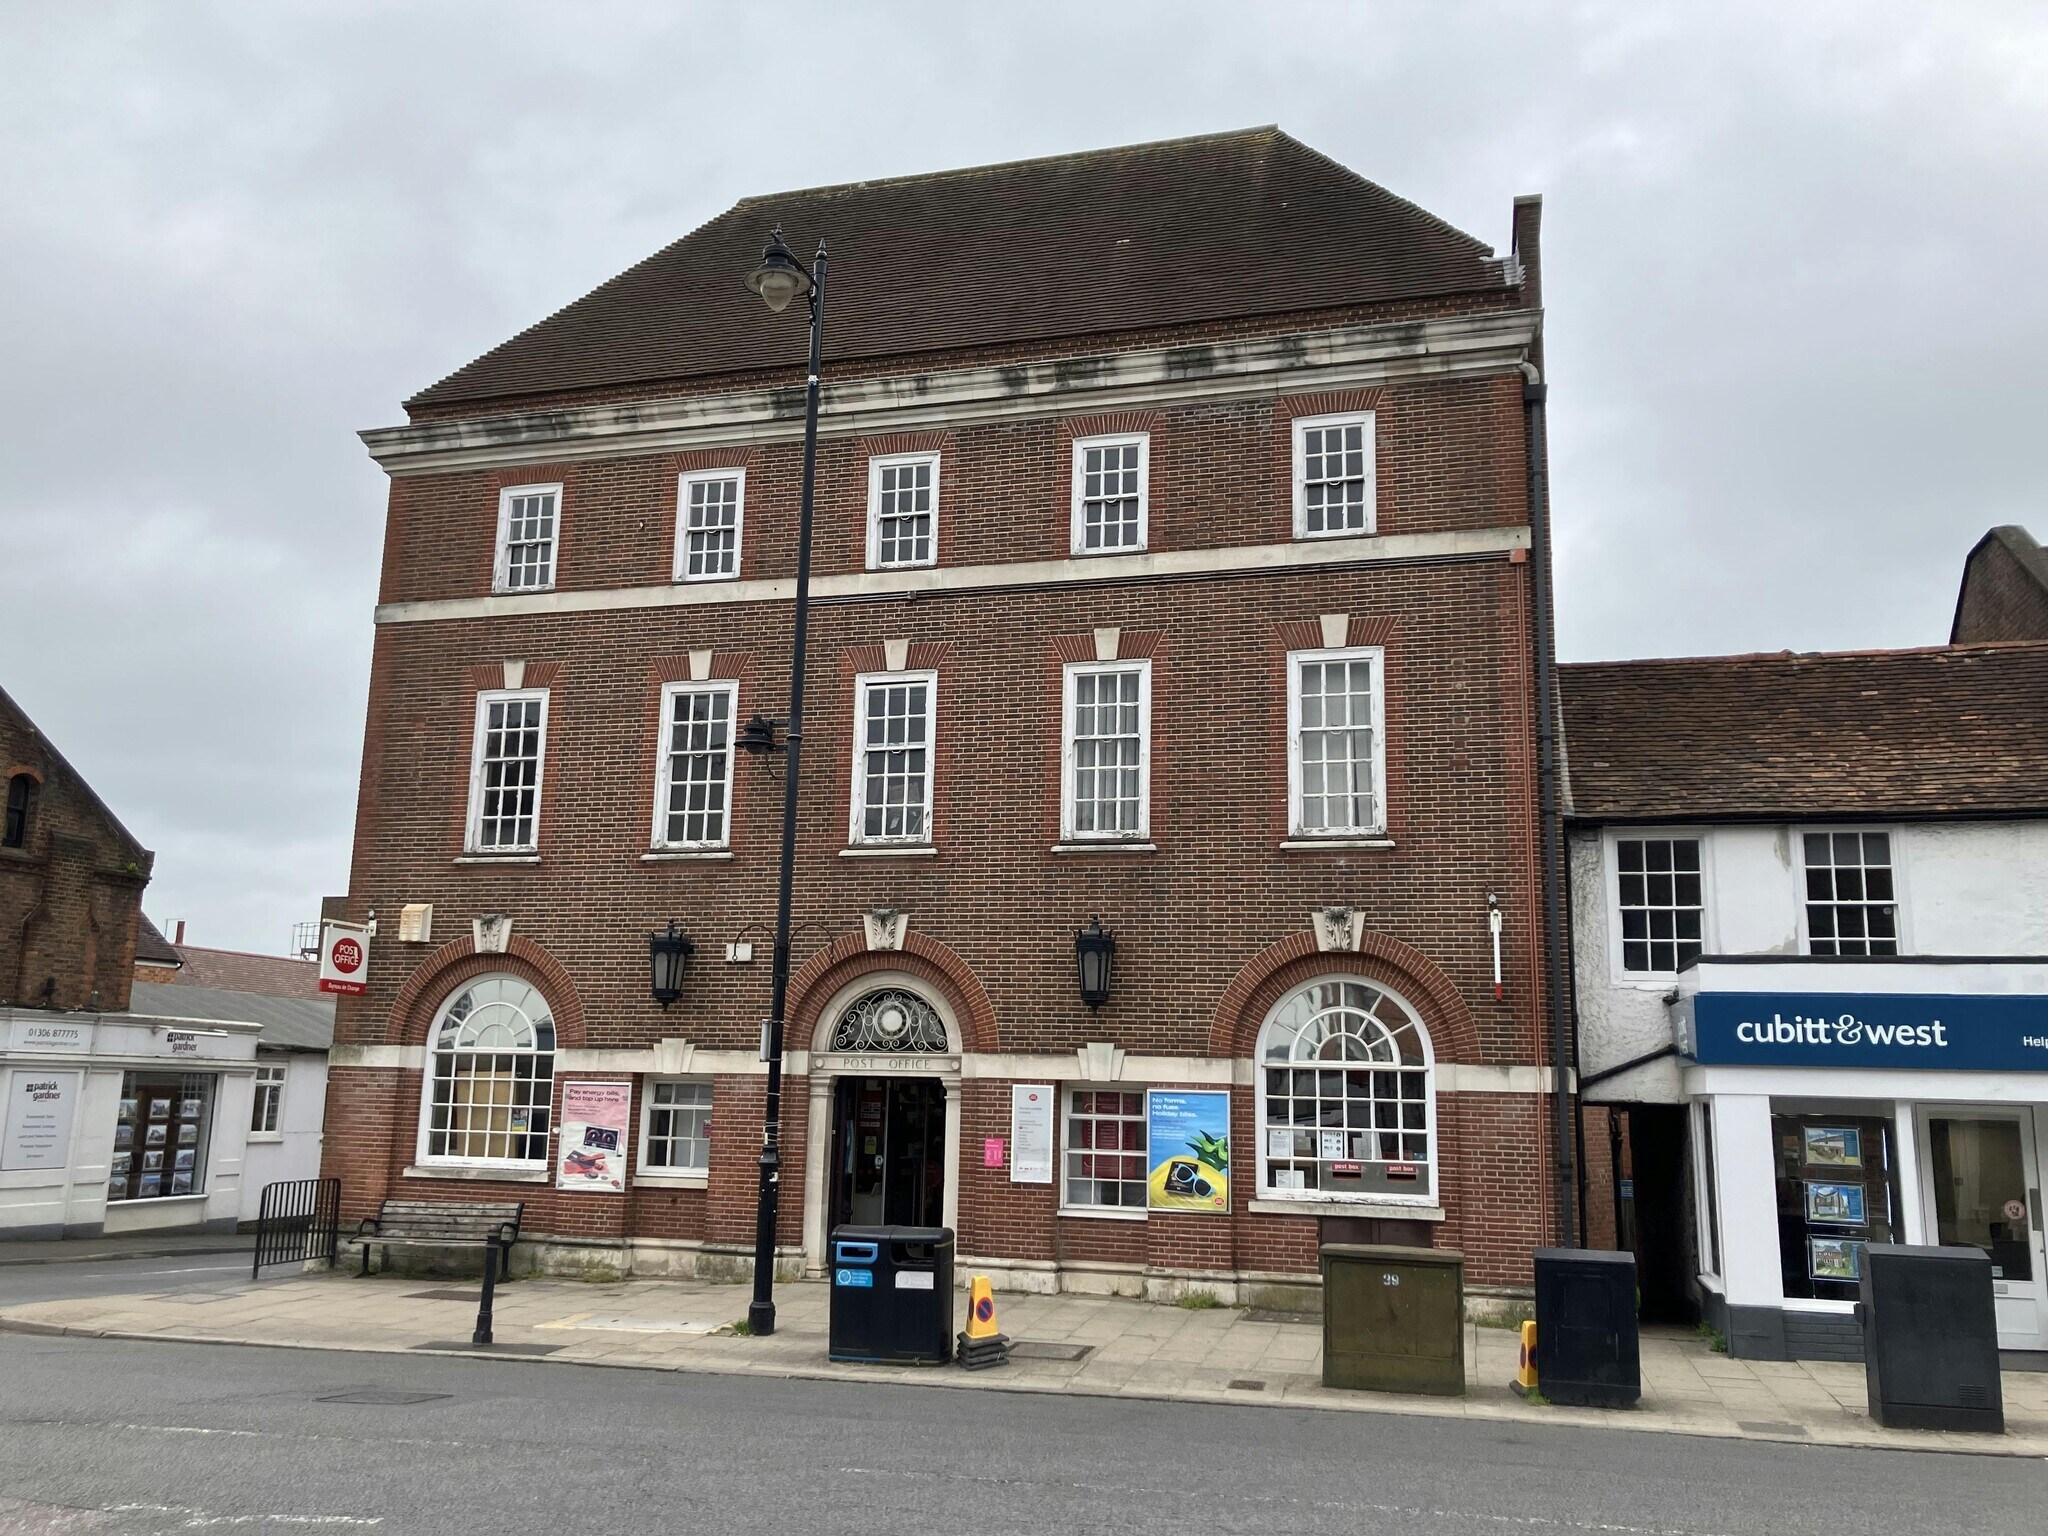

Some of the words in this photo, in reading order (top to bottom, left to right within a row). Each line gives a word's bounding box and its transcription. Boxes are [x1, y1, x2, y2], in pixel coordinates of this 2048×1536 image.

[334, 954, 359, 965] OFFICE
[28, 1027, 51, 1037] 01306
[172, 1041, 197, 1053] gardner
[843, 1058, 875, 1069] POST
[888, 1059, 931, 1070] OFFICE
[34, 1080, 58, 1091] patrick
[33, 1090, 61, 1102] gardner
[1152, 1110, 1179, 1118] Holiday
